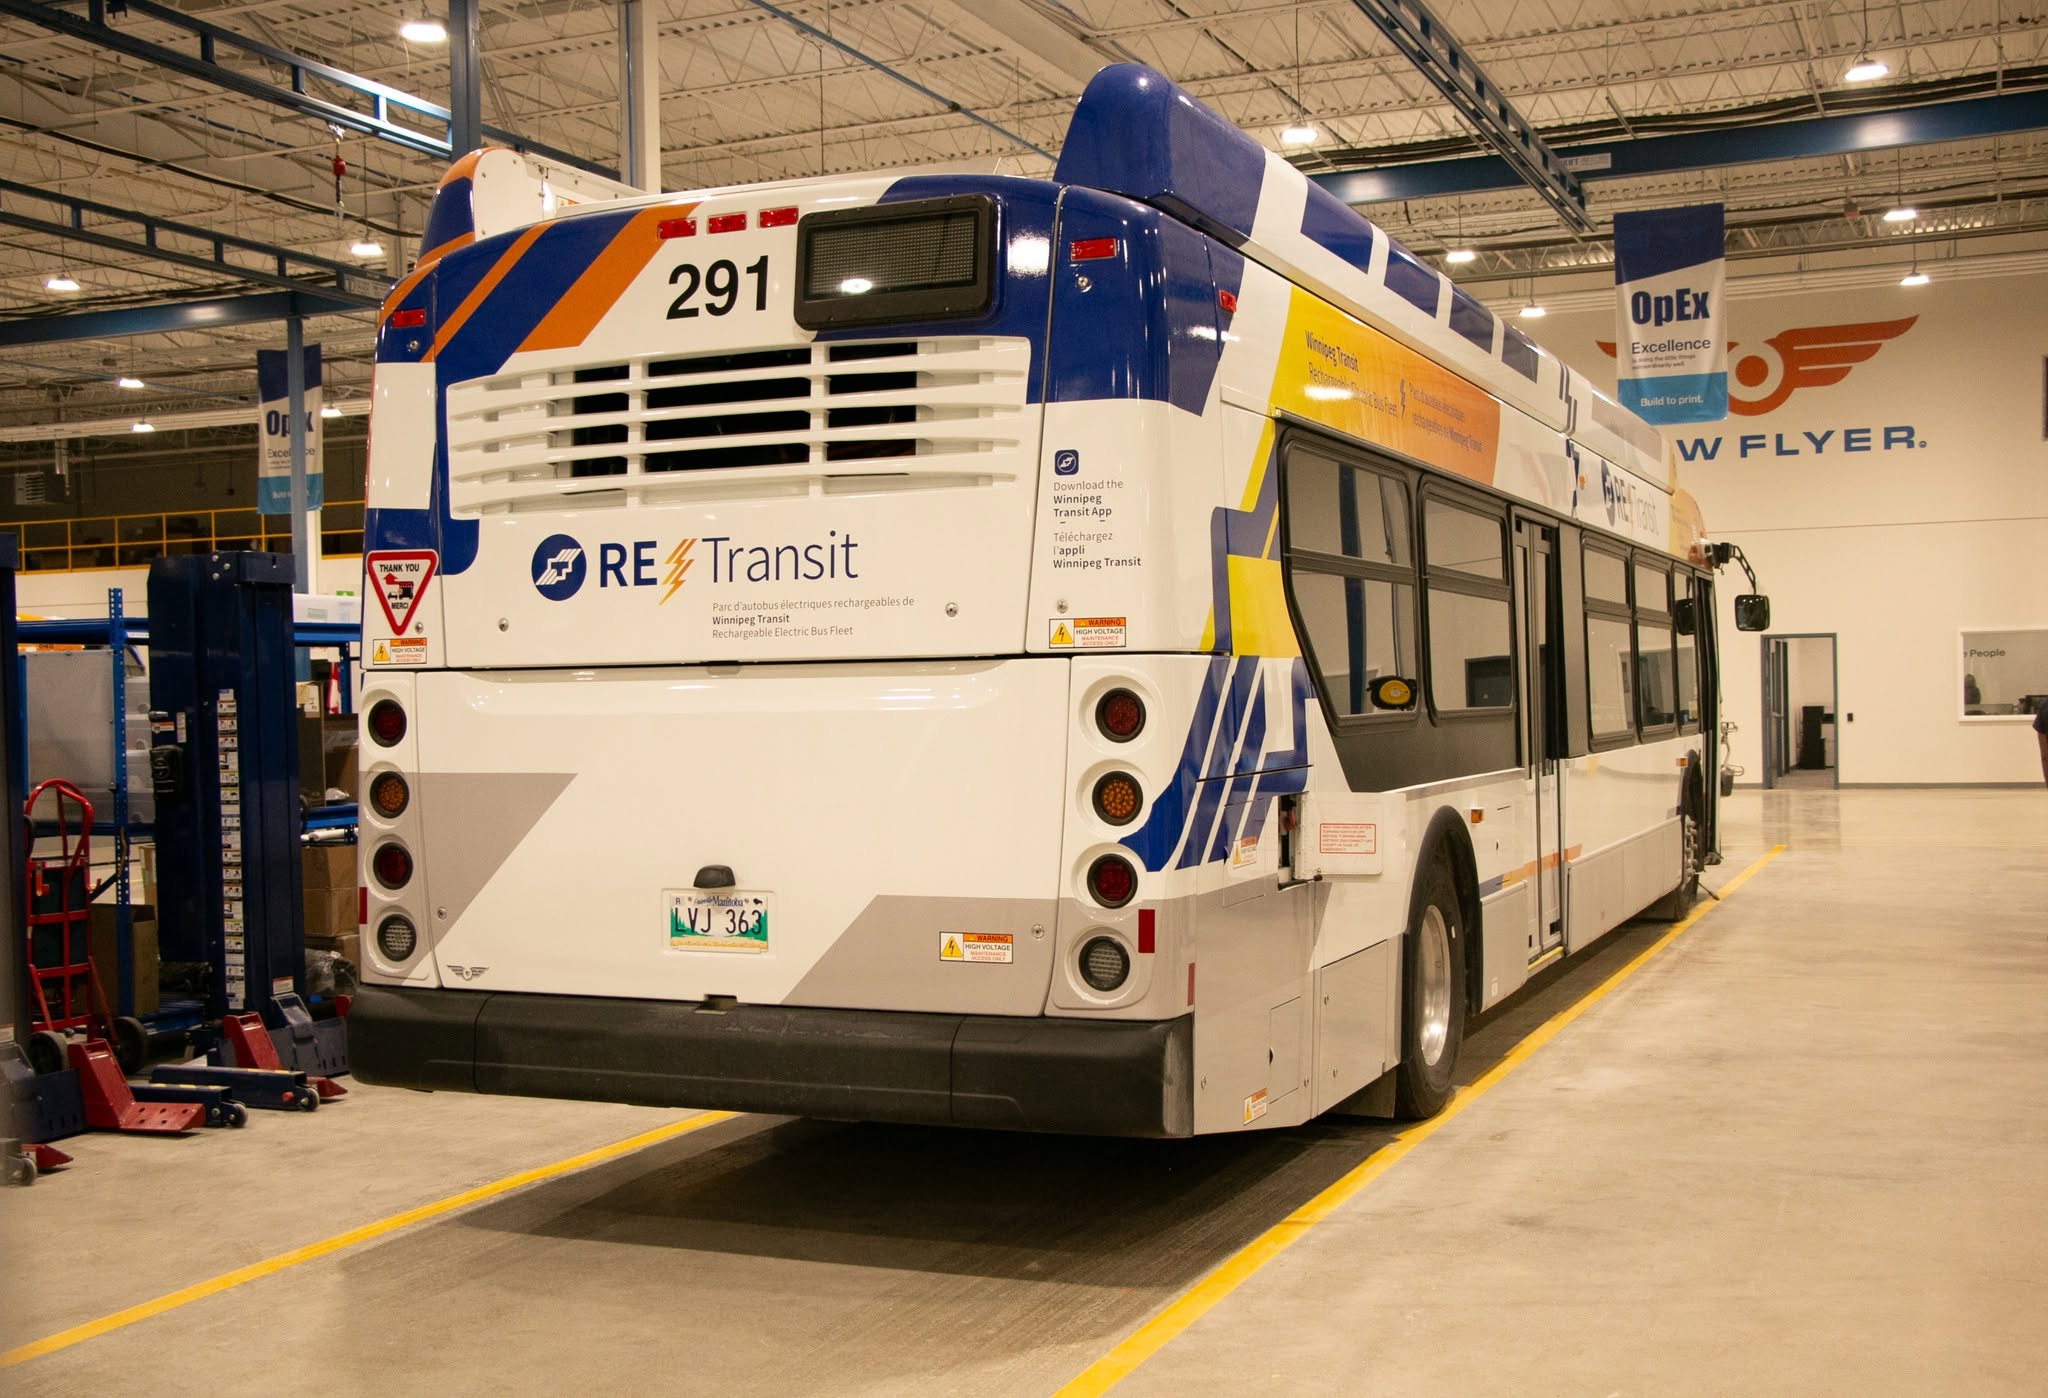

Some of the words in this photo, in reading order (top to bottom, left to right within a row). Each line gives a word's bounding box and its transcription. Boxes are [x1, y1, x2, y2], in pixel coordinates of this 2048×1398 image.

[666, 255, 769, 320] 291
[1632, 288, 1710, 326] OpEx
[1305, 330, 1337, 367] Winnipeg
[1336, 346, 1360, 373] Transit
[1631, 339, 1711, 354] Excellence
[1640, 397, 1664, 407] Build
[1666, 397, 1677, 405] to
[1678, 394, 1704, 405] print.
[267, 410, 314, 437] Opx
[1053, 480, 1104, 491] Download
[1107, 480, 1124, 489] the
[1053, 494, 1102, 505] Winnipeg
[1053, 507, 1090, 517] Transit
[1092, 507, 1112, 517] App
[1053, 531, 1113, 543] Téléchargez
[600, 540, 657, 588] RE
[702, 530, 858, 583] Transit
[1053, 558, 1102, 570] Winnipeg
[1104, 557, 1142, 567] Transit
[379, 564, 403, 572] THANK
[405, 563, 420, 572] YOU
[391, 602, 409, 610] MERCI
[712, 602, 732, 612] Parc
[734, 601, 779, 611] d'autobus
[780, 599, 832, 610] électriques
[834, 597, 901, 609] rechargeables
[902, 596, 915, 606] de
[712, 615, 755, 627] Winnipeg
[757, 613, 790, 625] Transit
[712, 628, 773, 640] Rechargeable
[774, 627, 809, 637] Electric
[811, 626, 828, 636] Bus
[830, 626, 853, 636] Fleet
[1969, 648, 2006, 658] People
[712, 896, 744, 907] Manitoba
[675, 907, 711, 933] LVJ
[726, 908, 762, 935] 363
